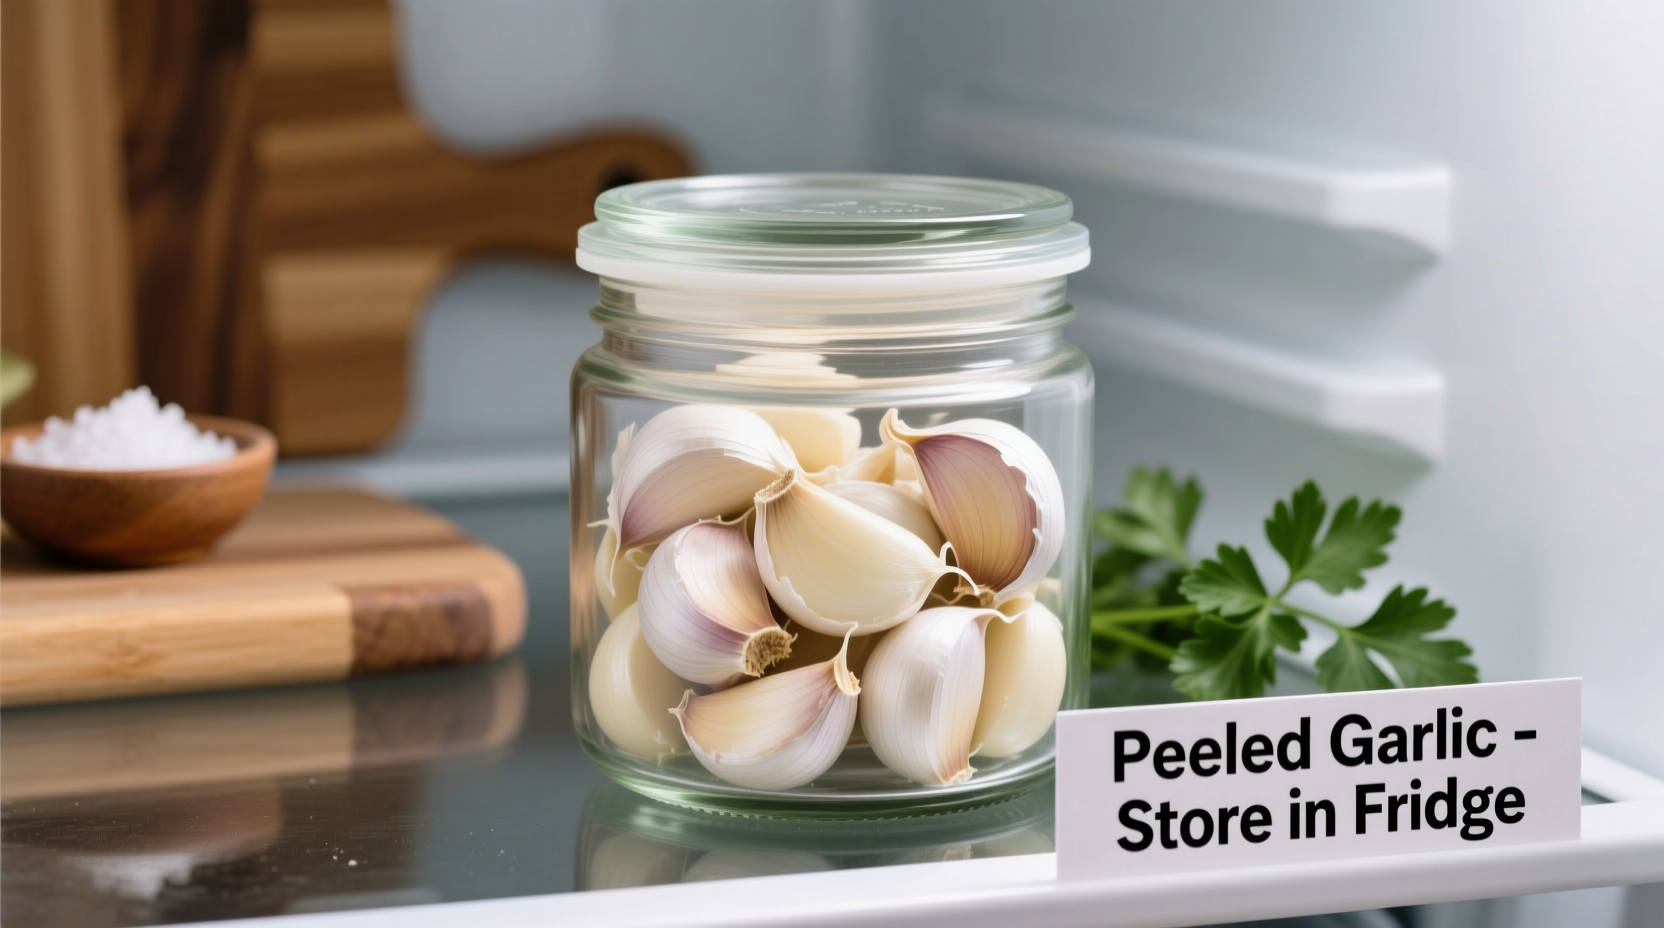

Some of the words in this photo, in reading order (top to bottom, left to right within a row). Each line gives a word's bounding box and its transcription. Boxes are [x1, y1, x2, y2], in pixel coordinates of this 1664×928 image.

[1112, 716, 1311, 783] Peeled
[1329, 706, 1498, 768] Garlic
[1116, 799, 1273, 853] Store
[1289, 787, 1336, 840] in
[1355, 776, 1526, 842] Fridge
